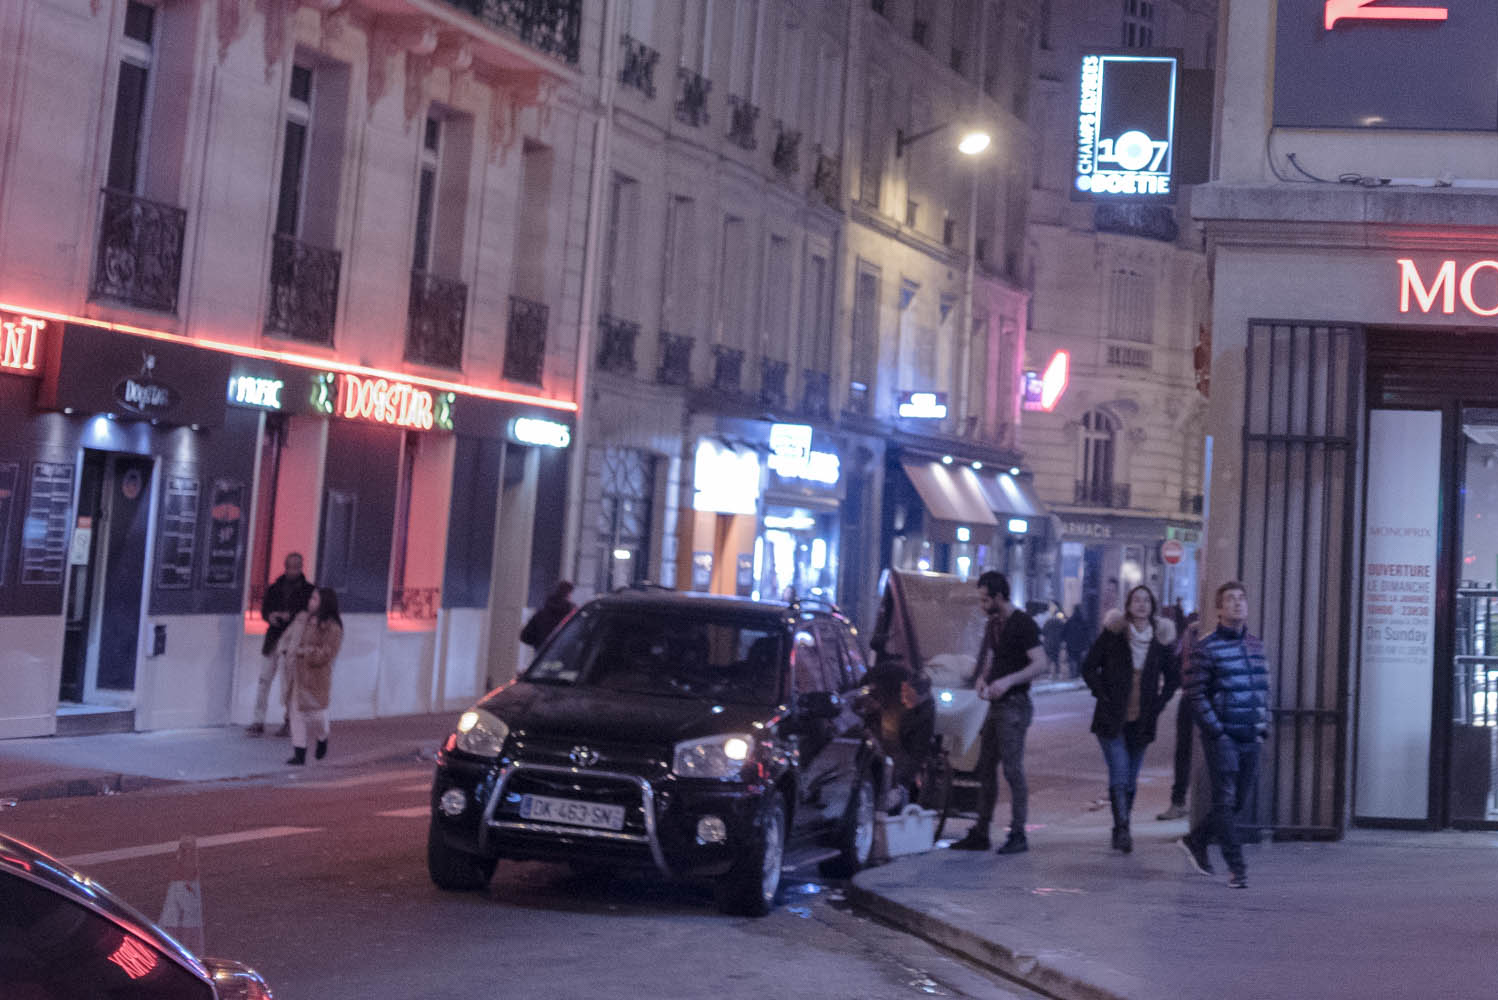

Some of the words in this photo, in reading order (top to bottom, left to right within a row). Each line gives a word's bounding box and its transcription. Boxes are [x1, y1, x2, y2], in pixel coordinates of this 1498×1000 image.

[0, 316, 46, 370] NT
[343, 373, 434, 430] DOGSTAR
[1367, 563, 1431, 578] OUVERTURE
[1384, 625, 1427, 645] Sunday
